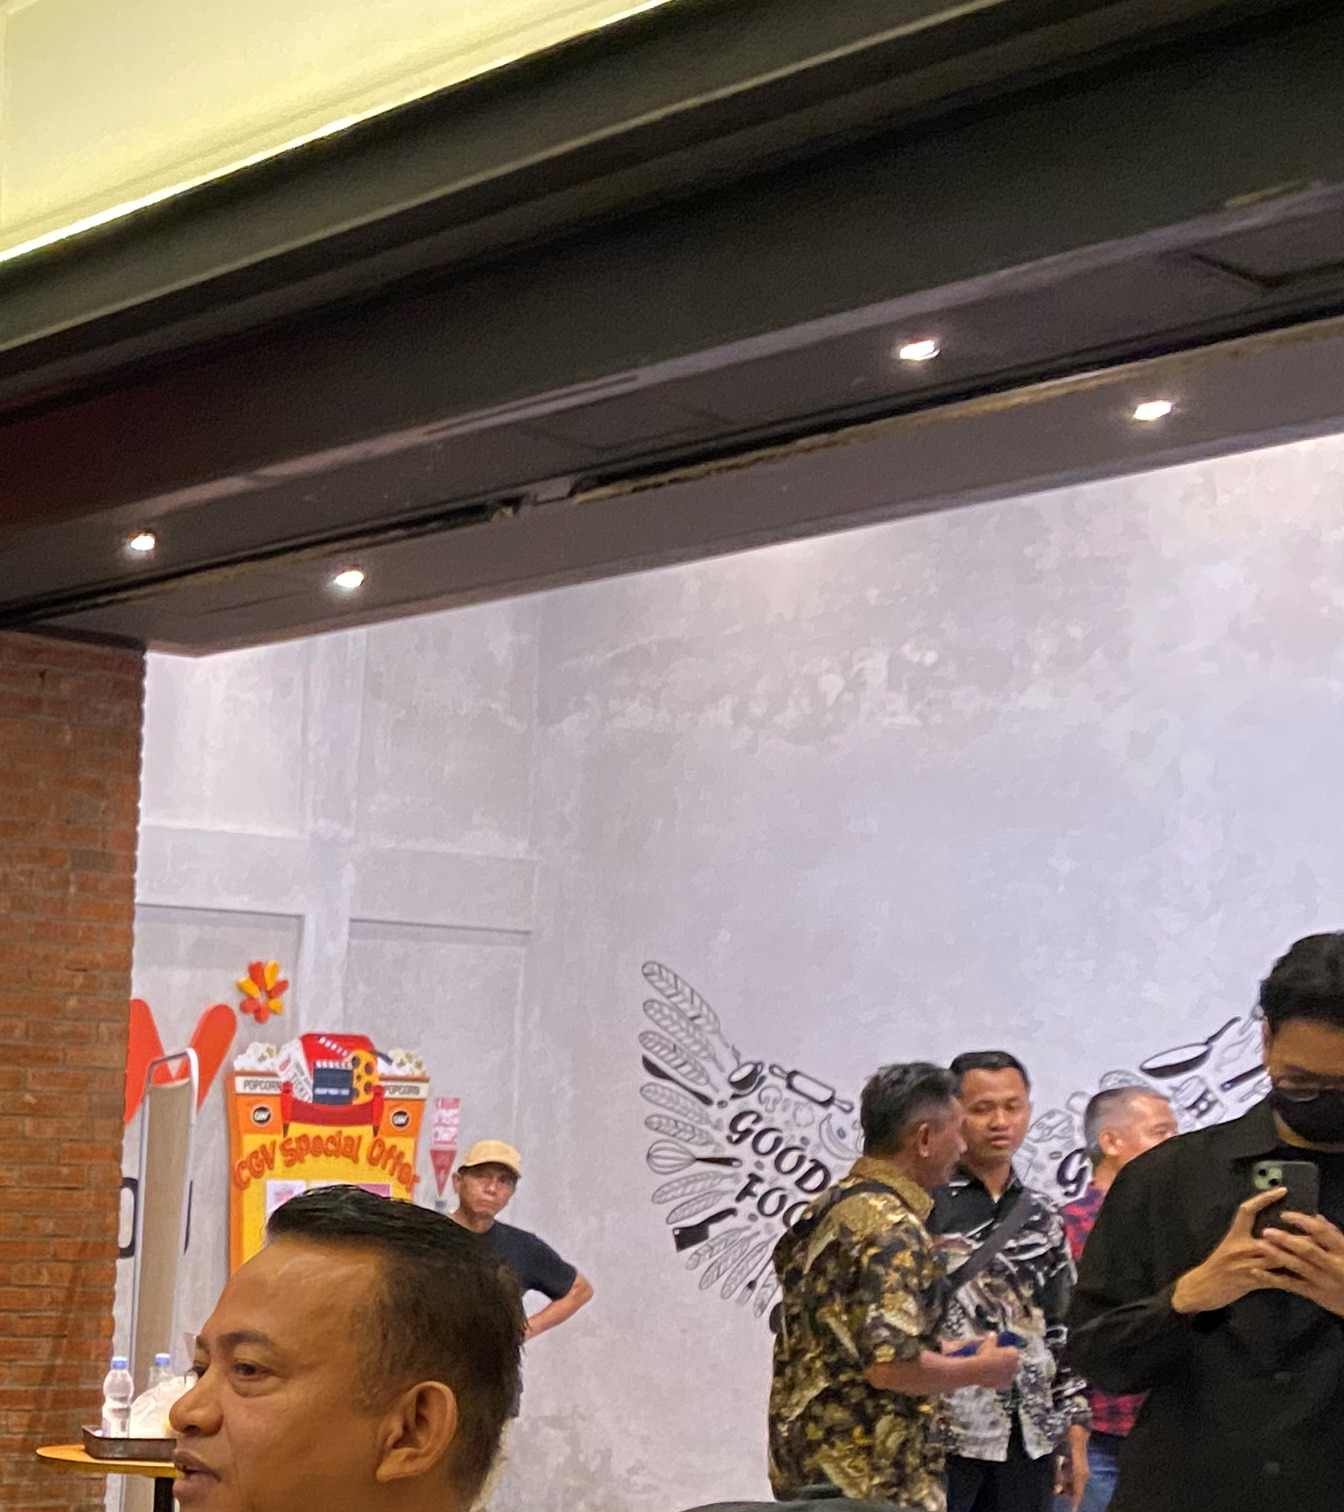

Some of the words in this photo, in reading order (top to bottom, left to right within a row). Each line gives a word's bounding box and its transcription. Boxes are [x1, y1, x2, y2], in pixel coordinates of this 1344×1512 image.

[233, 1138, 277, 1191] CGV
[279, 1130, 362, 1169] Special
[727, 1109, 833, 1195] GOOD
